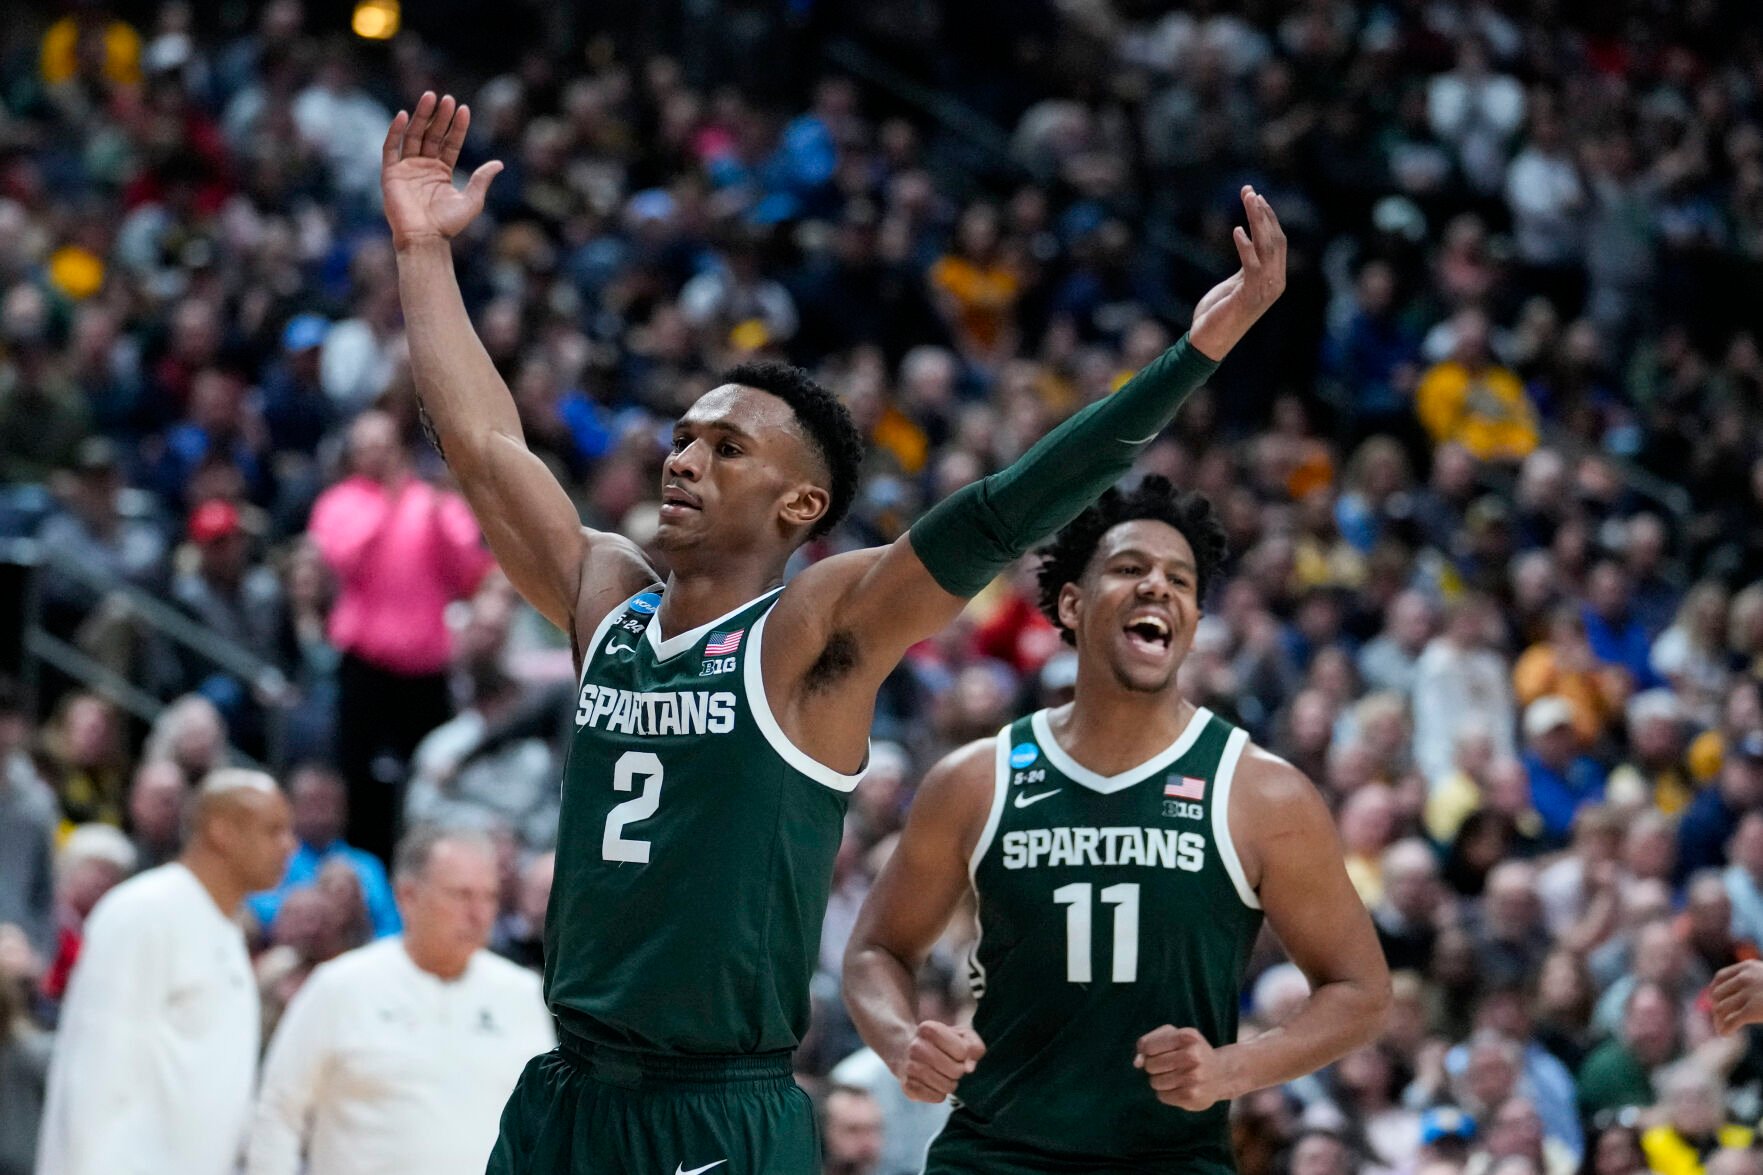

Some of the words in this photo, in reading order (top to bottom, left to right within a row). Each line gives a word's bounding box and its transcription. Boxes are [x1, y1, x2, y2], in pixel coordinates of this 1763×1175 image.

[615, 614, 645, 634] 5-24
[575, 685, 736, 735] SPARTANS
[602, 751, 664, 863] 2
[1003, 826, 1205, 872] SPARTANS
[1053, 882, 1140, 983] 11
